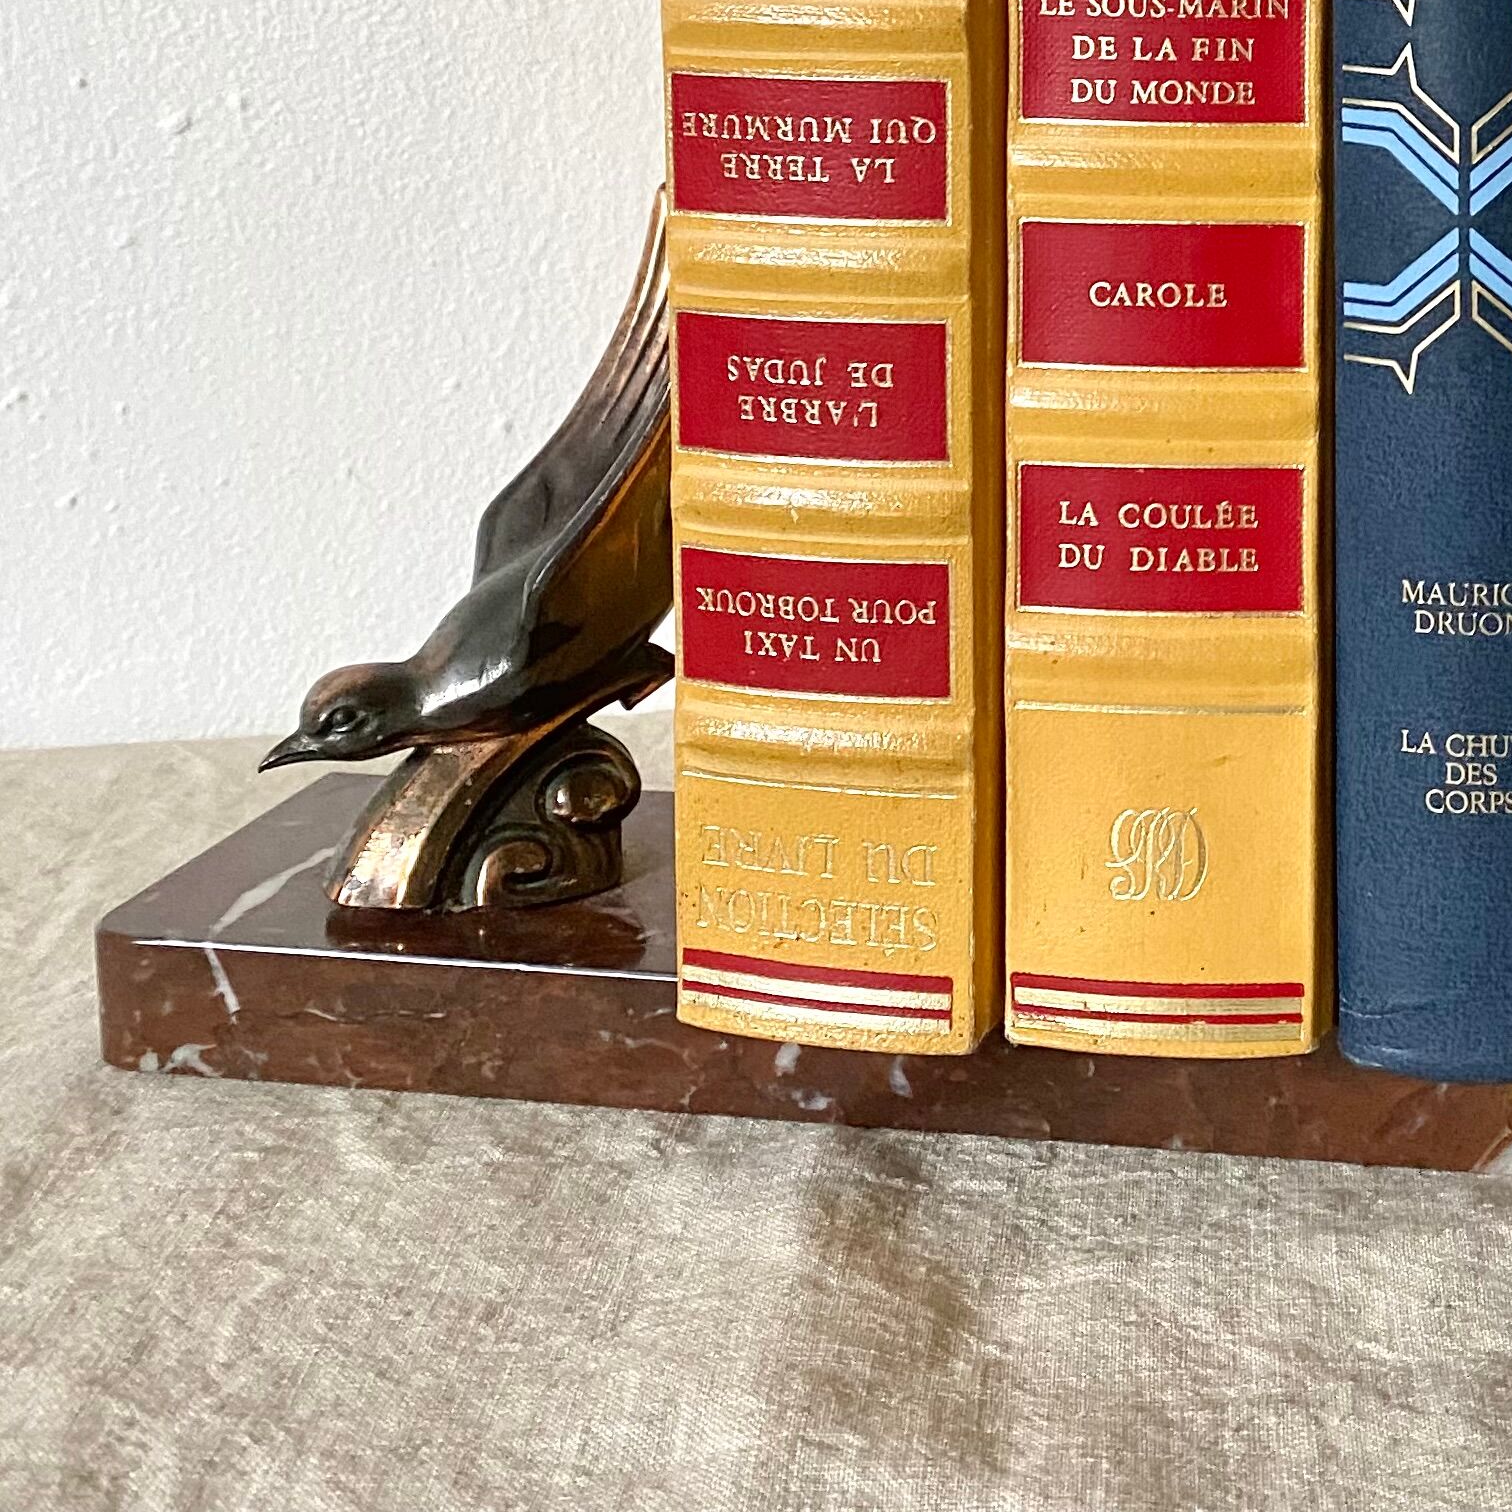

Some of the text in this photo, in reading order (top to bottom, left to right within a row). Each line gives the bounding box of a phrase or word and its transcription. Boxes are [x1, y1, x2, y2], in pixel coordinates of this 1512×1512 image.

[1071, 35, 1255, 63] DE LA FIN
[1070, 79, 1256, 105] DU MONDE
[681, 111, 937, 145] QUI MURMURE
[720, 151, 896, 184] LA TERRE
[1089, 281, 1228, 308] CAROLE
[726, 354, 895, 388] DE JUDAS
[739, 395, 879, 428] L'ARBRE
[1058, 500, 1260, 530] LA COULÉE
[1058, 543, 1260, 573] DU DIABLE
[696, 586, 938, 627] POUR TOBROUK
[743, 629, 882, 664] UN TAXI
[1400, 729, 1437, 755] LA
[1444, 762, 1498, 786] DES
[700, 824, 939, 887] DU LIVRE
[695, 884, 940, 958] SÉLECTION
